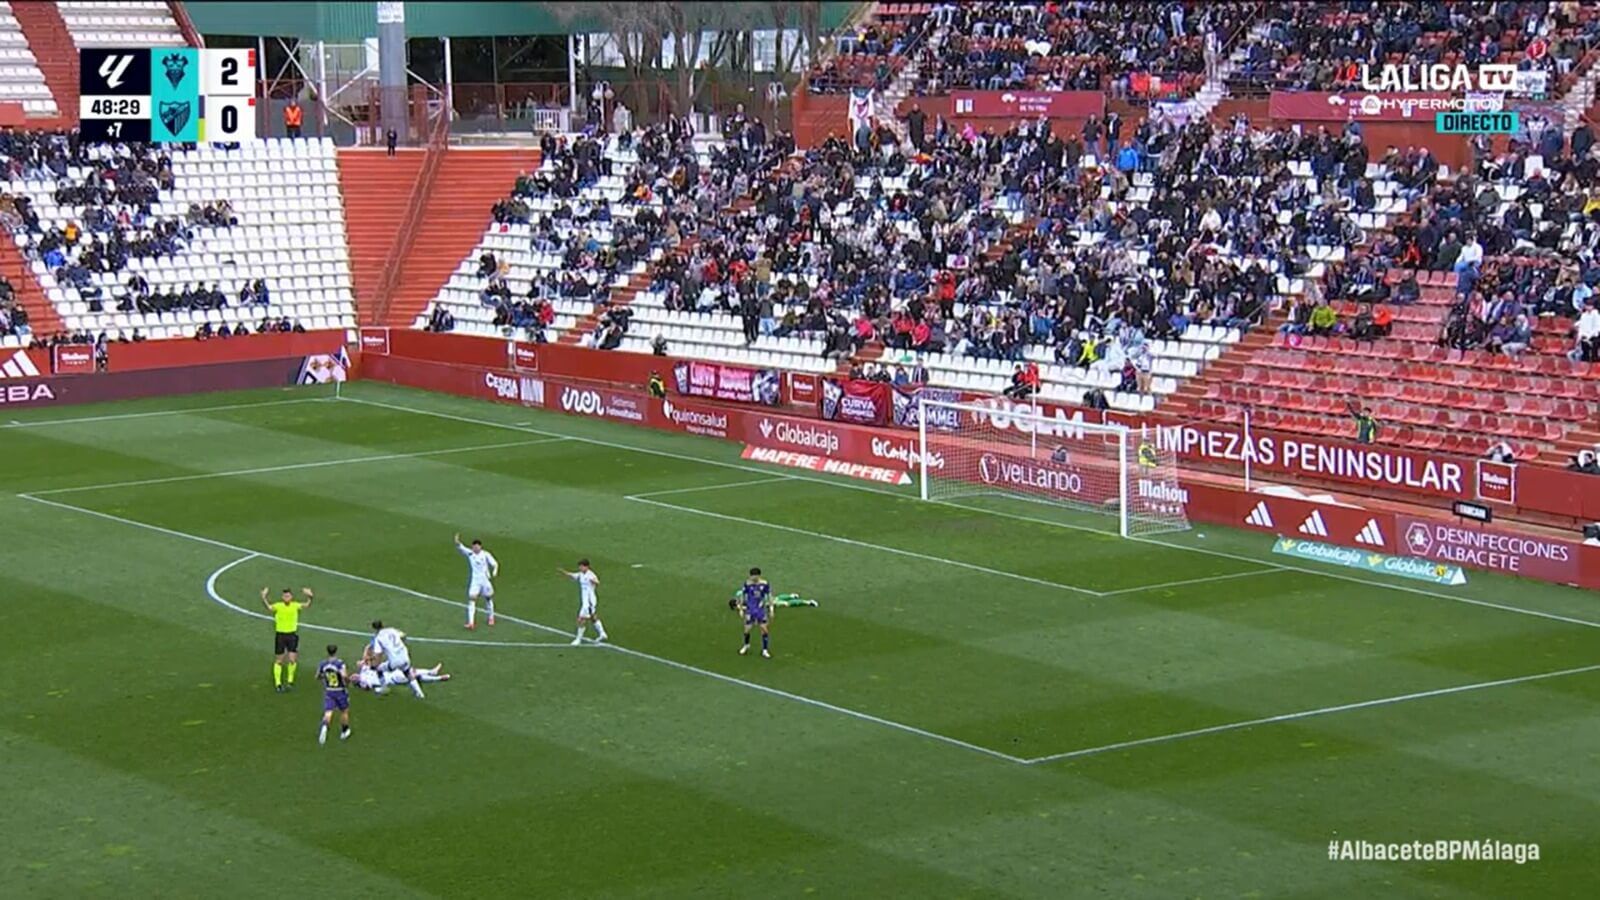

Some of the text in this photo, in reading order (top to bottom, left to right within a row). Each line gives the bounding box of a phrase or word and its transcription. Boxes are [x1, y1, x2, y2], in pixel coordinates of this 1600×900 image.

[0, 384, 54, 402] BA
[776, 422, 839, 455] Globalcaja
[750, 447, 897, 483] MAPFRE MAPFRE
[1283, 440, 1462, 493] PENINSULAR
[1436, 526, 1569, 561] DESINFECCIONES
[1436, 544, 1520, 571] ALBACETE
[1297, 541, 1454, 582] Globalcaja Globalcja
